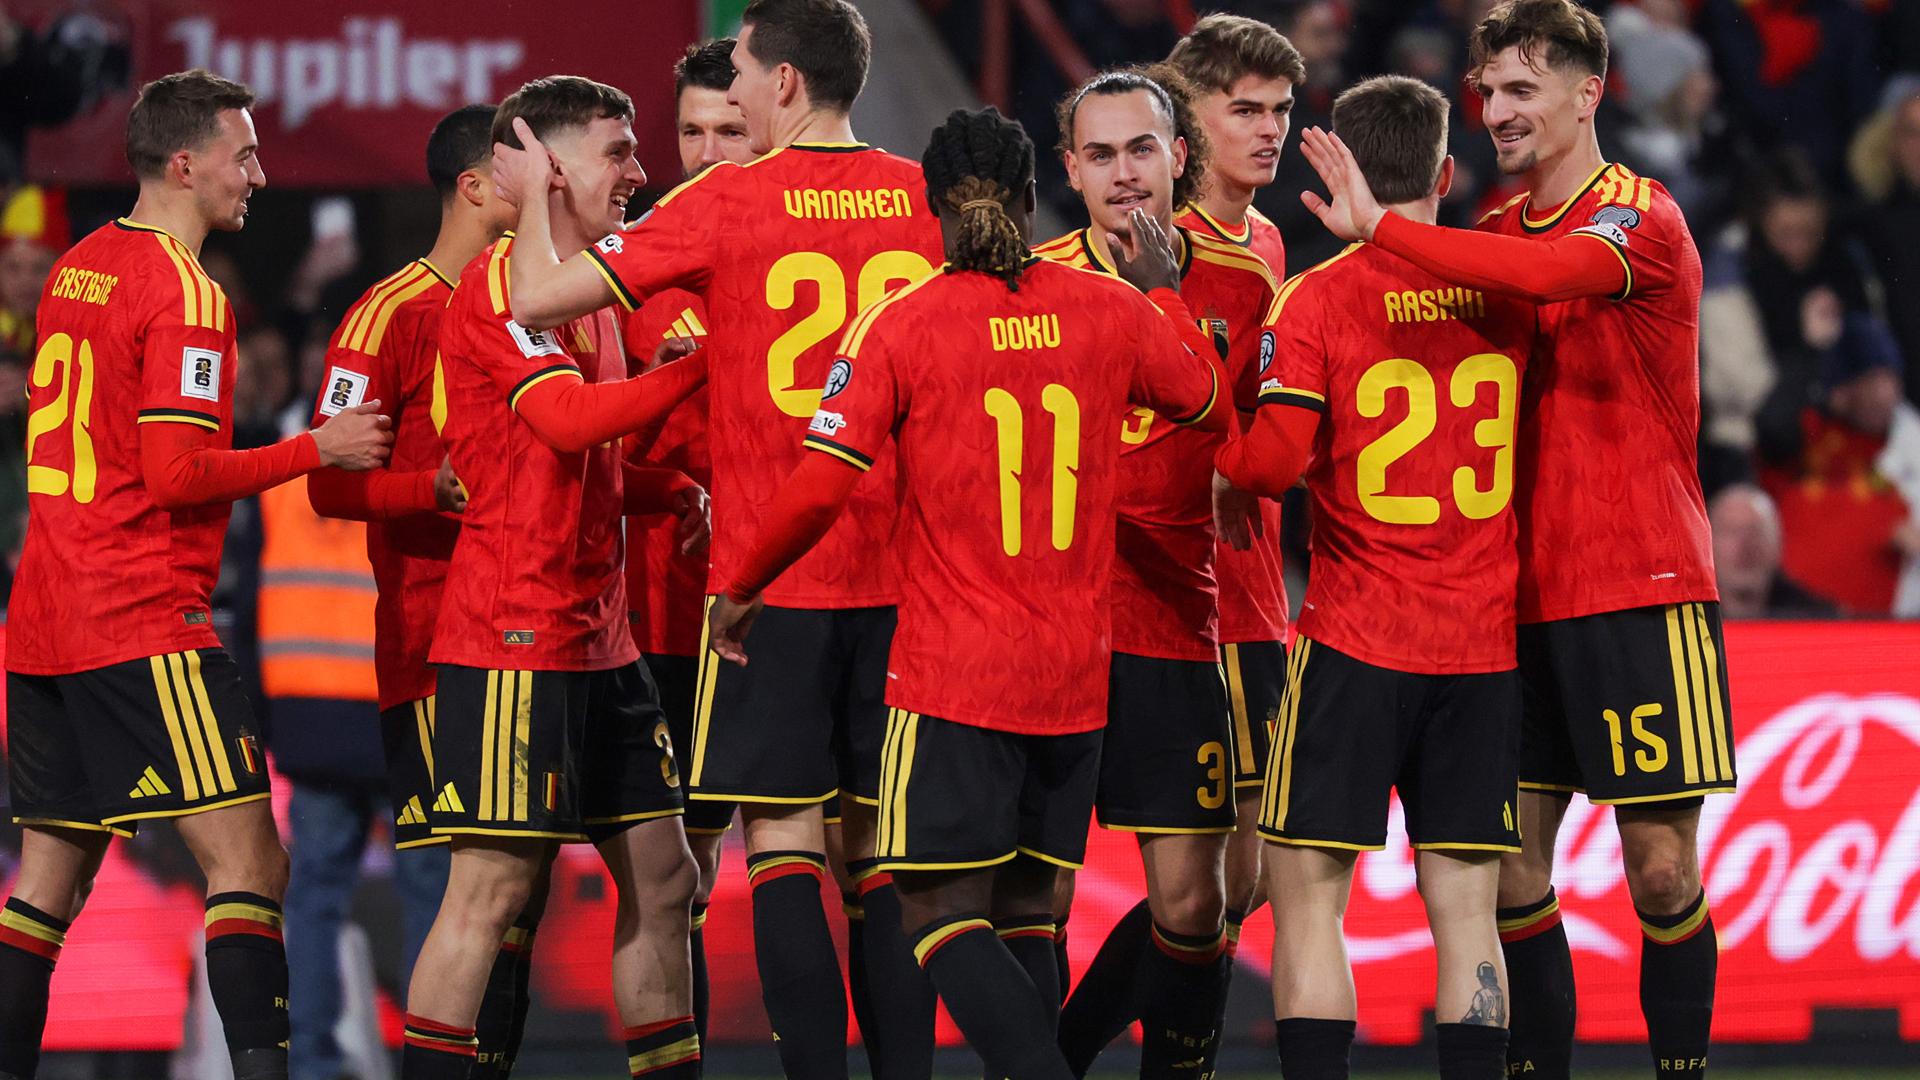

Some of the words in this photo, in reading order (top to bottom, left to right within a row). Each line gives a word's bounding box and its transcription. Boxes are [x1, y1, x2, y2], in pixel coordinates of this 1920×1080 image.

[168, 18, 524, 130] Jupiler
[784, 188, 912, 220] VANAKEN
[989, 313, 1061, 351] DOKU
[1384, 287, 1485, 323] RASKIN
[28, 332, 97, 504] 21
[1356, 353, 1517, 524] 23
[984, 383, 1080, 557] 11
[1602, 703, 1668, 776] 15
[1196, 741, 1226, 809] 3
[1660, 1056, 1707, 1071] RBFA
